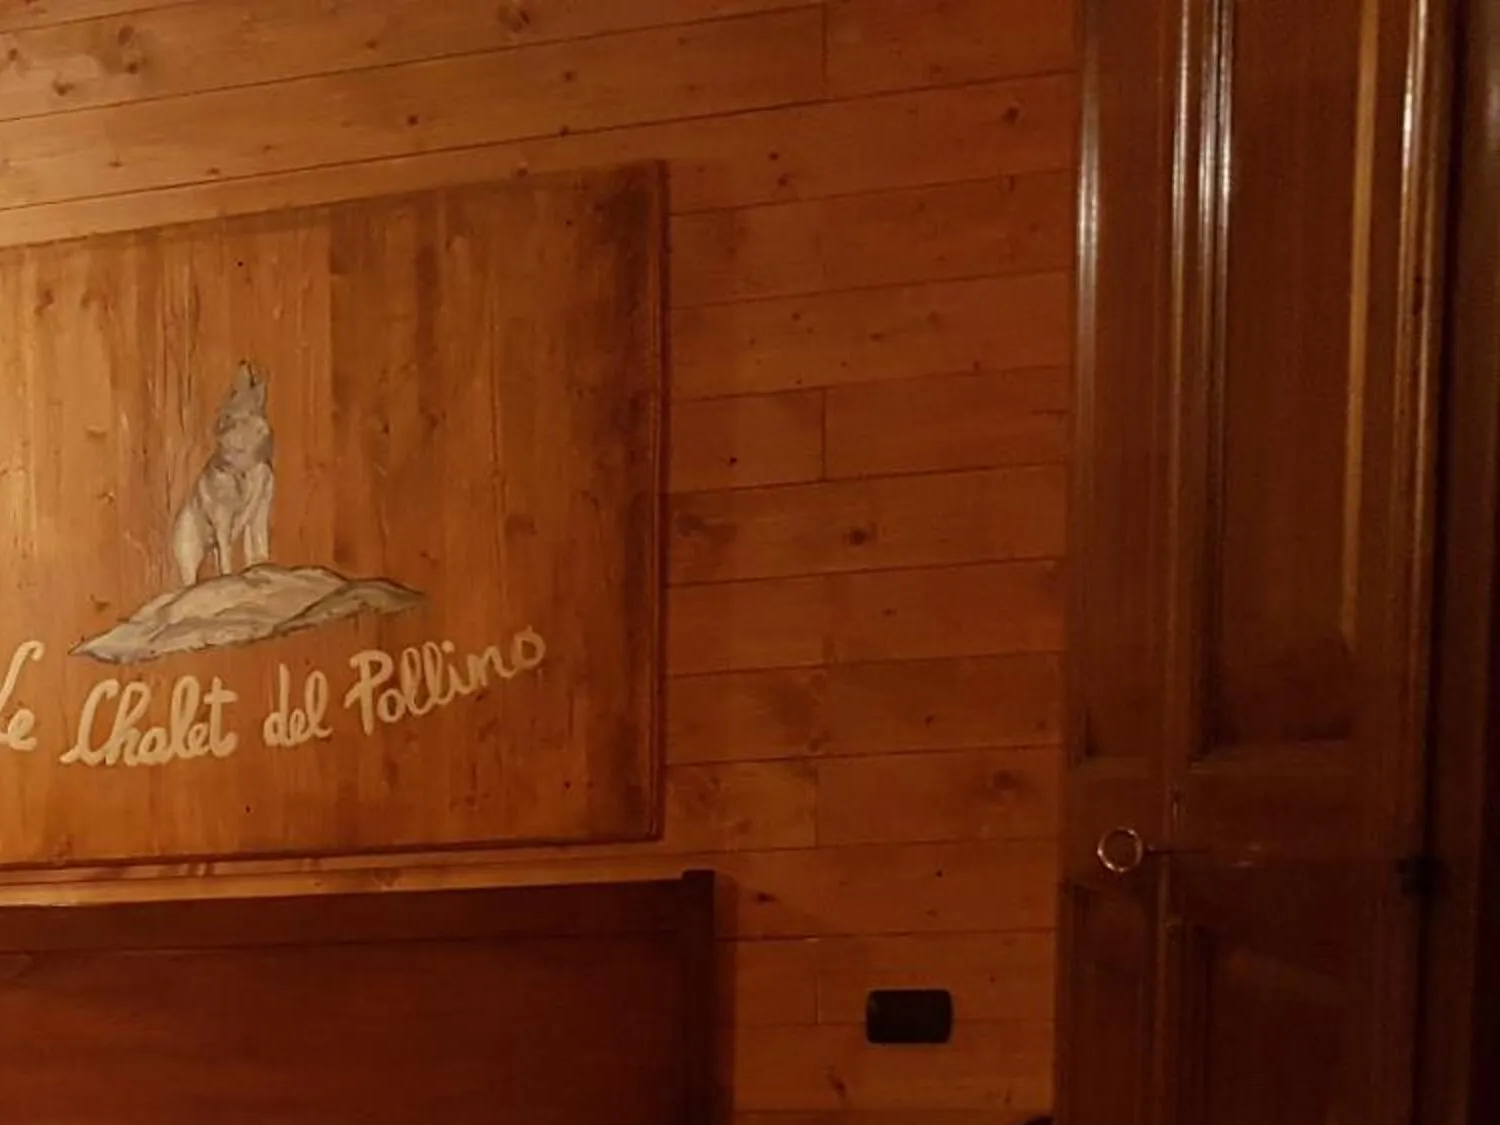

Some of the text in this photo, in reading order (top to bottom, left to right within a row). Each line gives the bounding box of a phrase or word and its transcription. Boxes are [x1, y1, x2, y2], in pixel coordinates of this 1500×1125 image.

[60, 675, 239, 766] Chalet
[263, 664, 333, 747] del
[345, 625, 546, 735] Pollino
